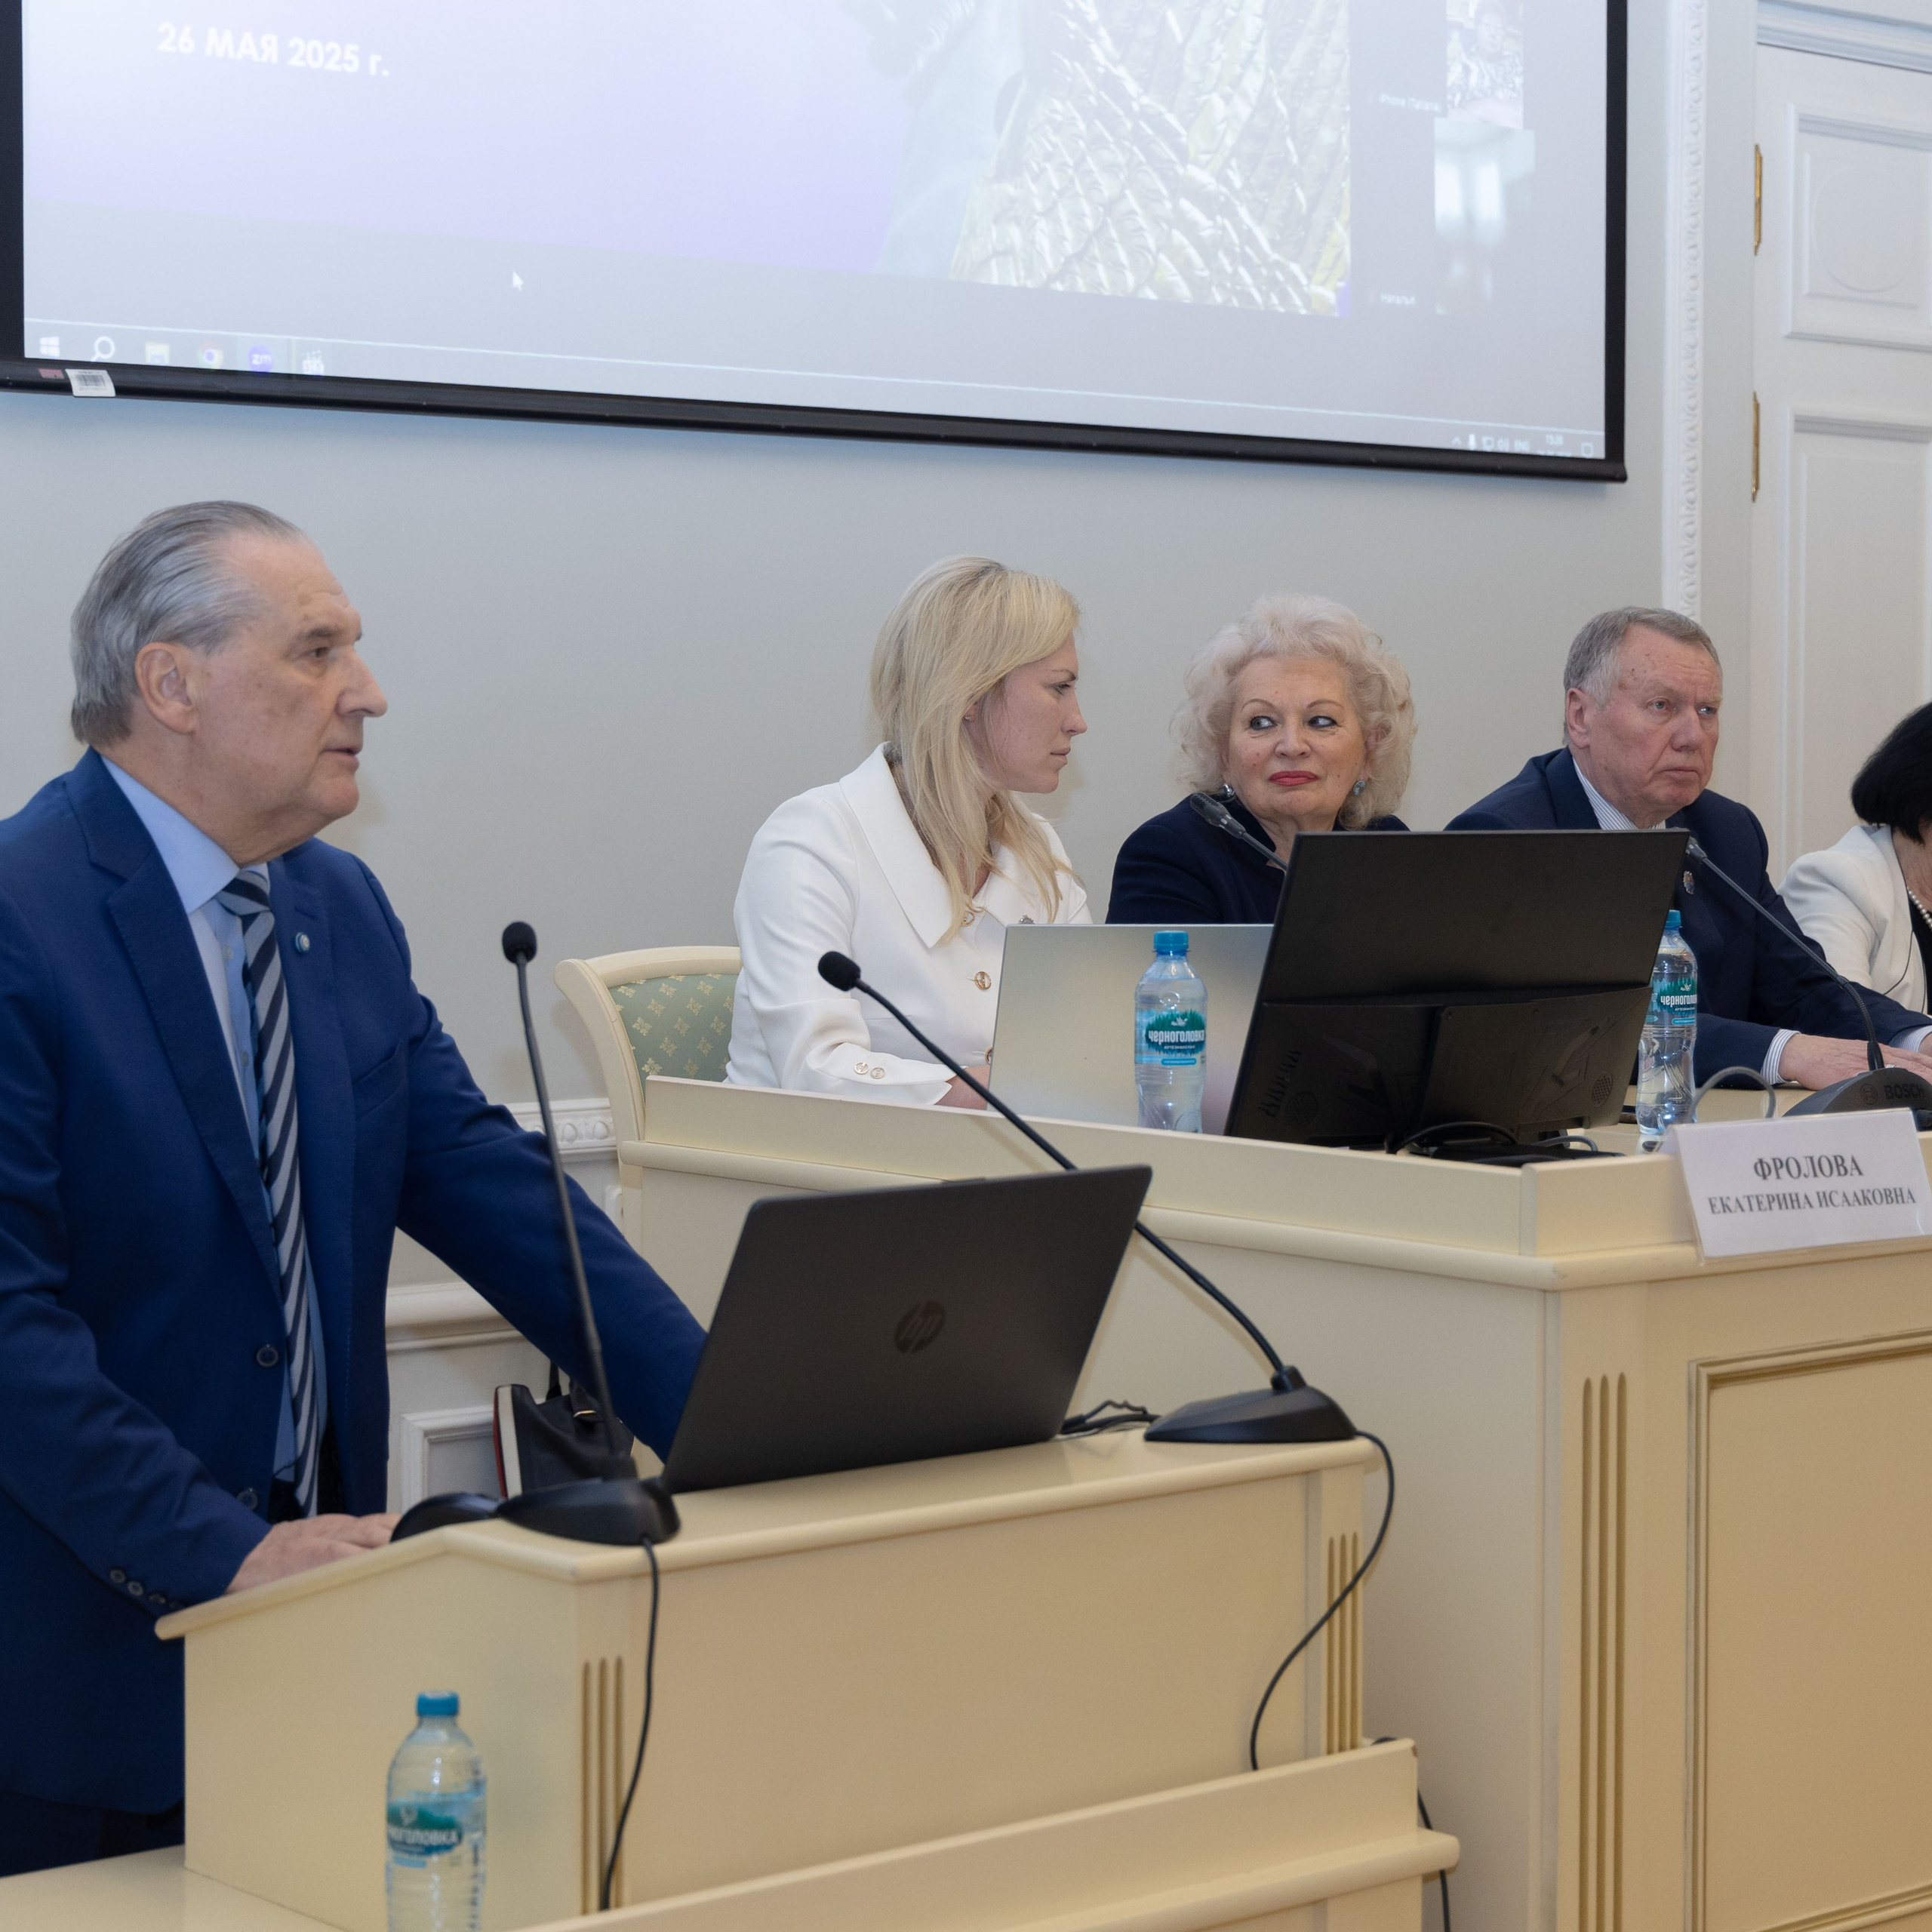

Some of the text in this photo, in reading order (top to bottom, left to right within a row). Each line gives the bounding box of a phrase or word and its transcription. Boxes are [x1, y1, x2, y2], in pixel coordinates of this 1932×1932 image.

[157, 21, 389, 76] 26 МАЯ 2025 г.
[1884, 1083, 1926, 1100] BOSCH
[1753, 1154, 1864, 1180] ФРОЛОВА
[1708, 1187, 1917, 1215] ЕКАТЕРИНА ИСААКОВНА
